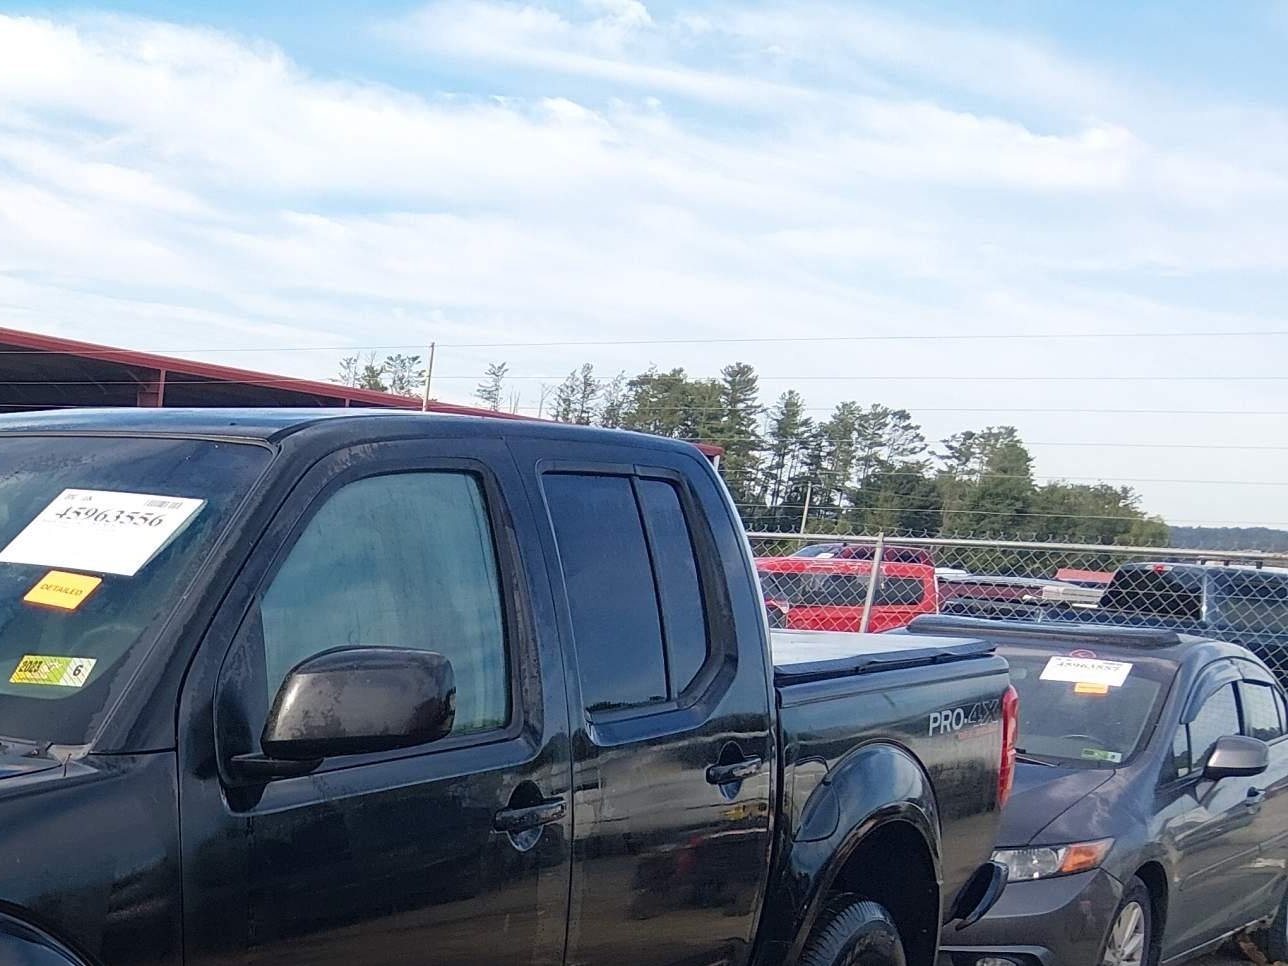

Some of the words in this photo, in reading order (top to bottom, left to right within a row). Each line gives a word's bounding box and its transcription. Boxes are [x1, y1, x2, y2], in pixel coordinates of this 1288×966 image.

[55, 506, 167, 526] 45963556
[40, 583, 83, 596] DETAILED
[73, 664, 84, 677] 6
